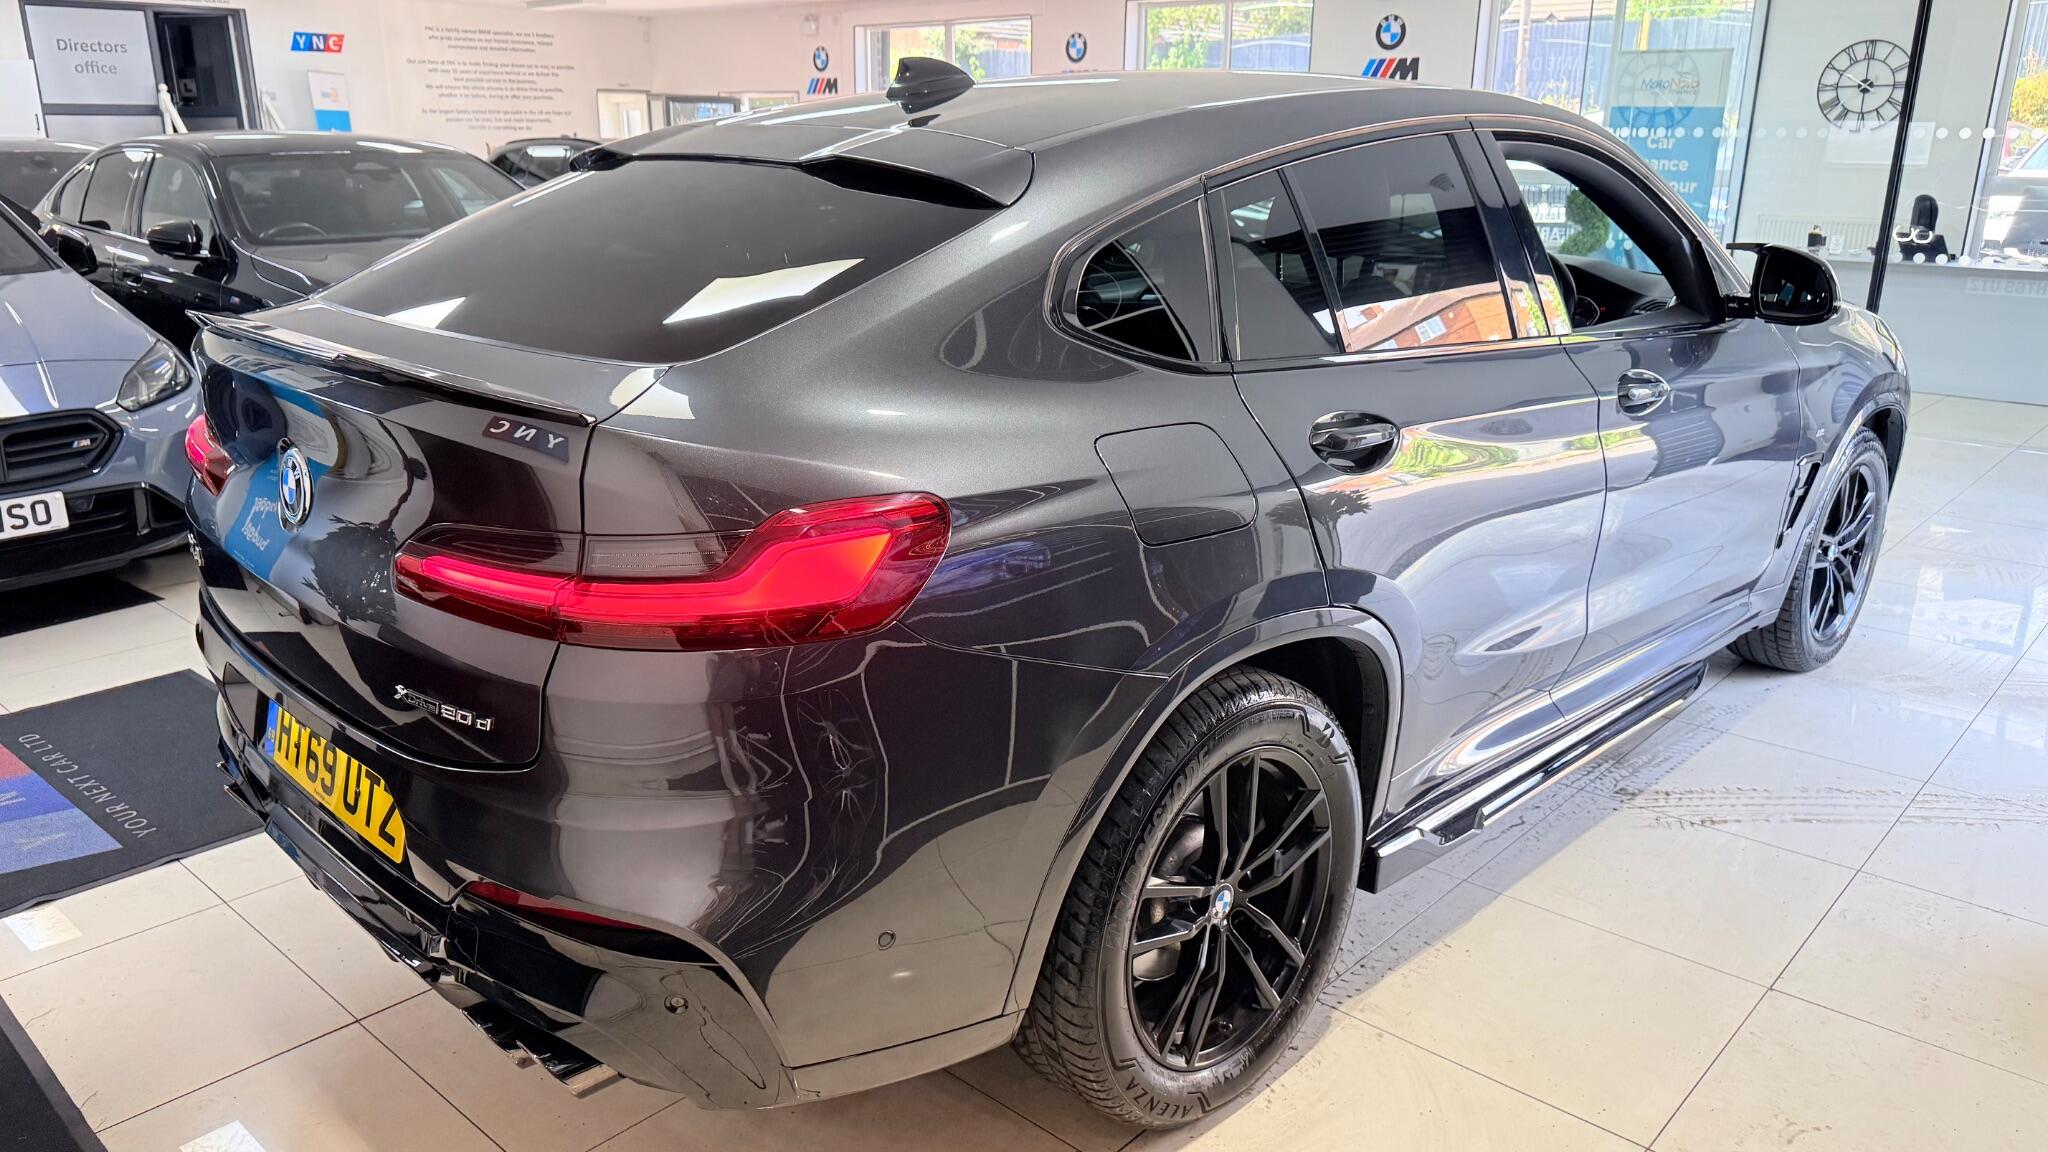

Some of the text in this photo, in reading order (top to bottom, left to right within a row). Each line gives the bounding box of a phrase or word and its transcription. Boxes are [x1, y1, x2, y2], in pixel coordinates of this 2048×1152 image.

[56, 38, 128, 53] Directors
[295, 34, 340, 50] YNC
[75, 60, 117, 74] office
[1647, 136, 1676, 150] Car
[1647, 159, 1689, 172] ance
[1669, 181, 1698, 193] our
[0, 499, 52, 533] SO
[277, 707, 397, 848] HT69 UTZ
[18, 733, 157, 838] YOUR NEXT CAR LTD
[1125, 1075, 1194, 1119] ALENZA
